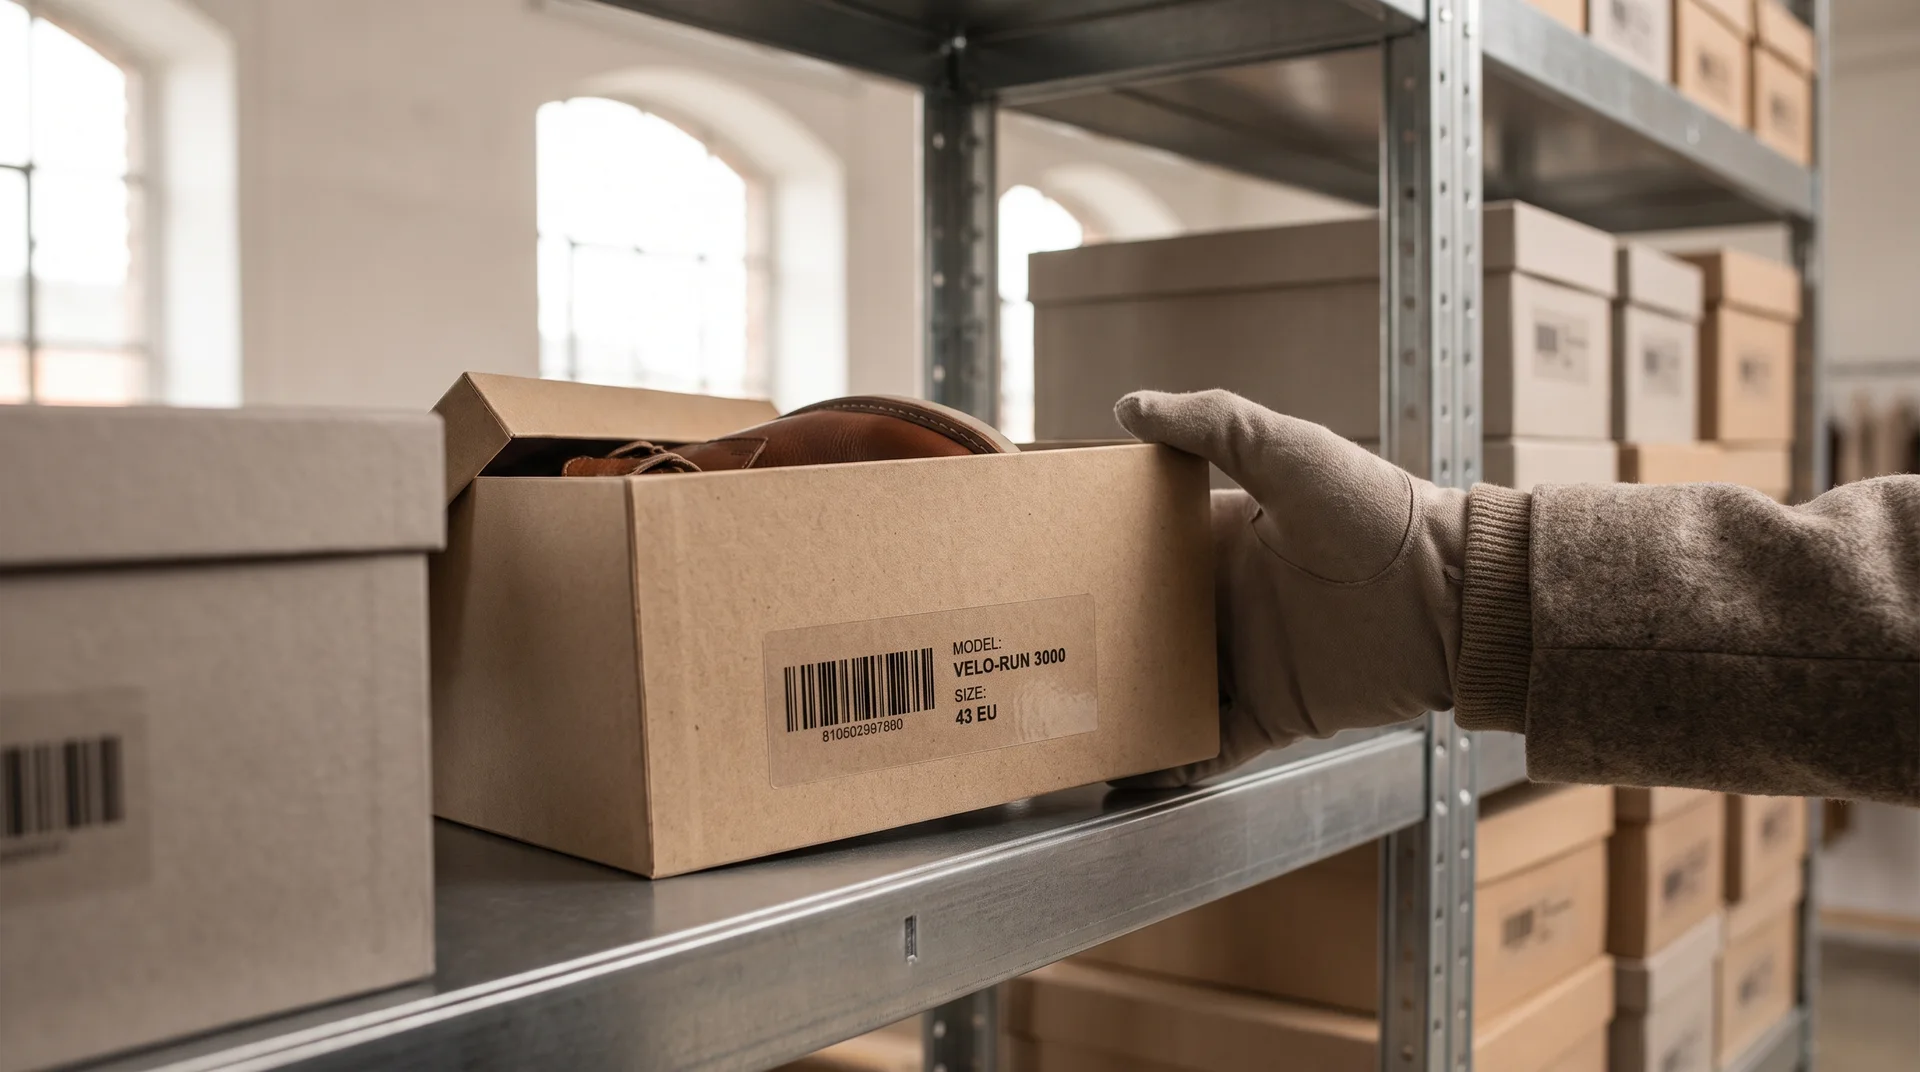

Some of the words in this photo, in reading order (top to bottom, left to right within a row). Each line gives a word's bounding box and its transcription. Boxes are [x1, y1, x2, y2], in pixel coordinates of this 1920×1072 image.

[953, 637, 1002, 655] MODEL:
[953, 652, 1030, 677] VELO-RUN
[1034, 647, 1066, 666] 3000
[954, 686, 987, 702] SIZE:
[955, 708, 973, 725] 43
[977, 704, 997, 722] EU
